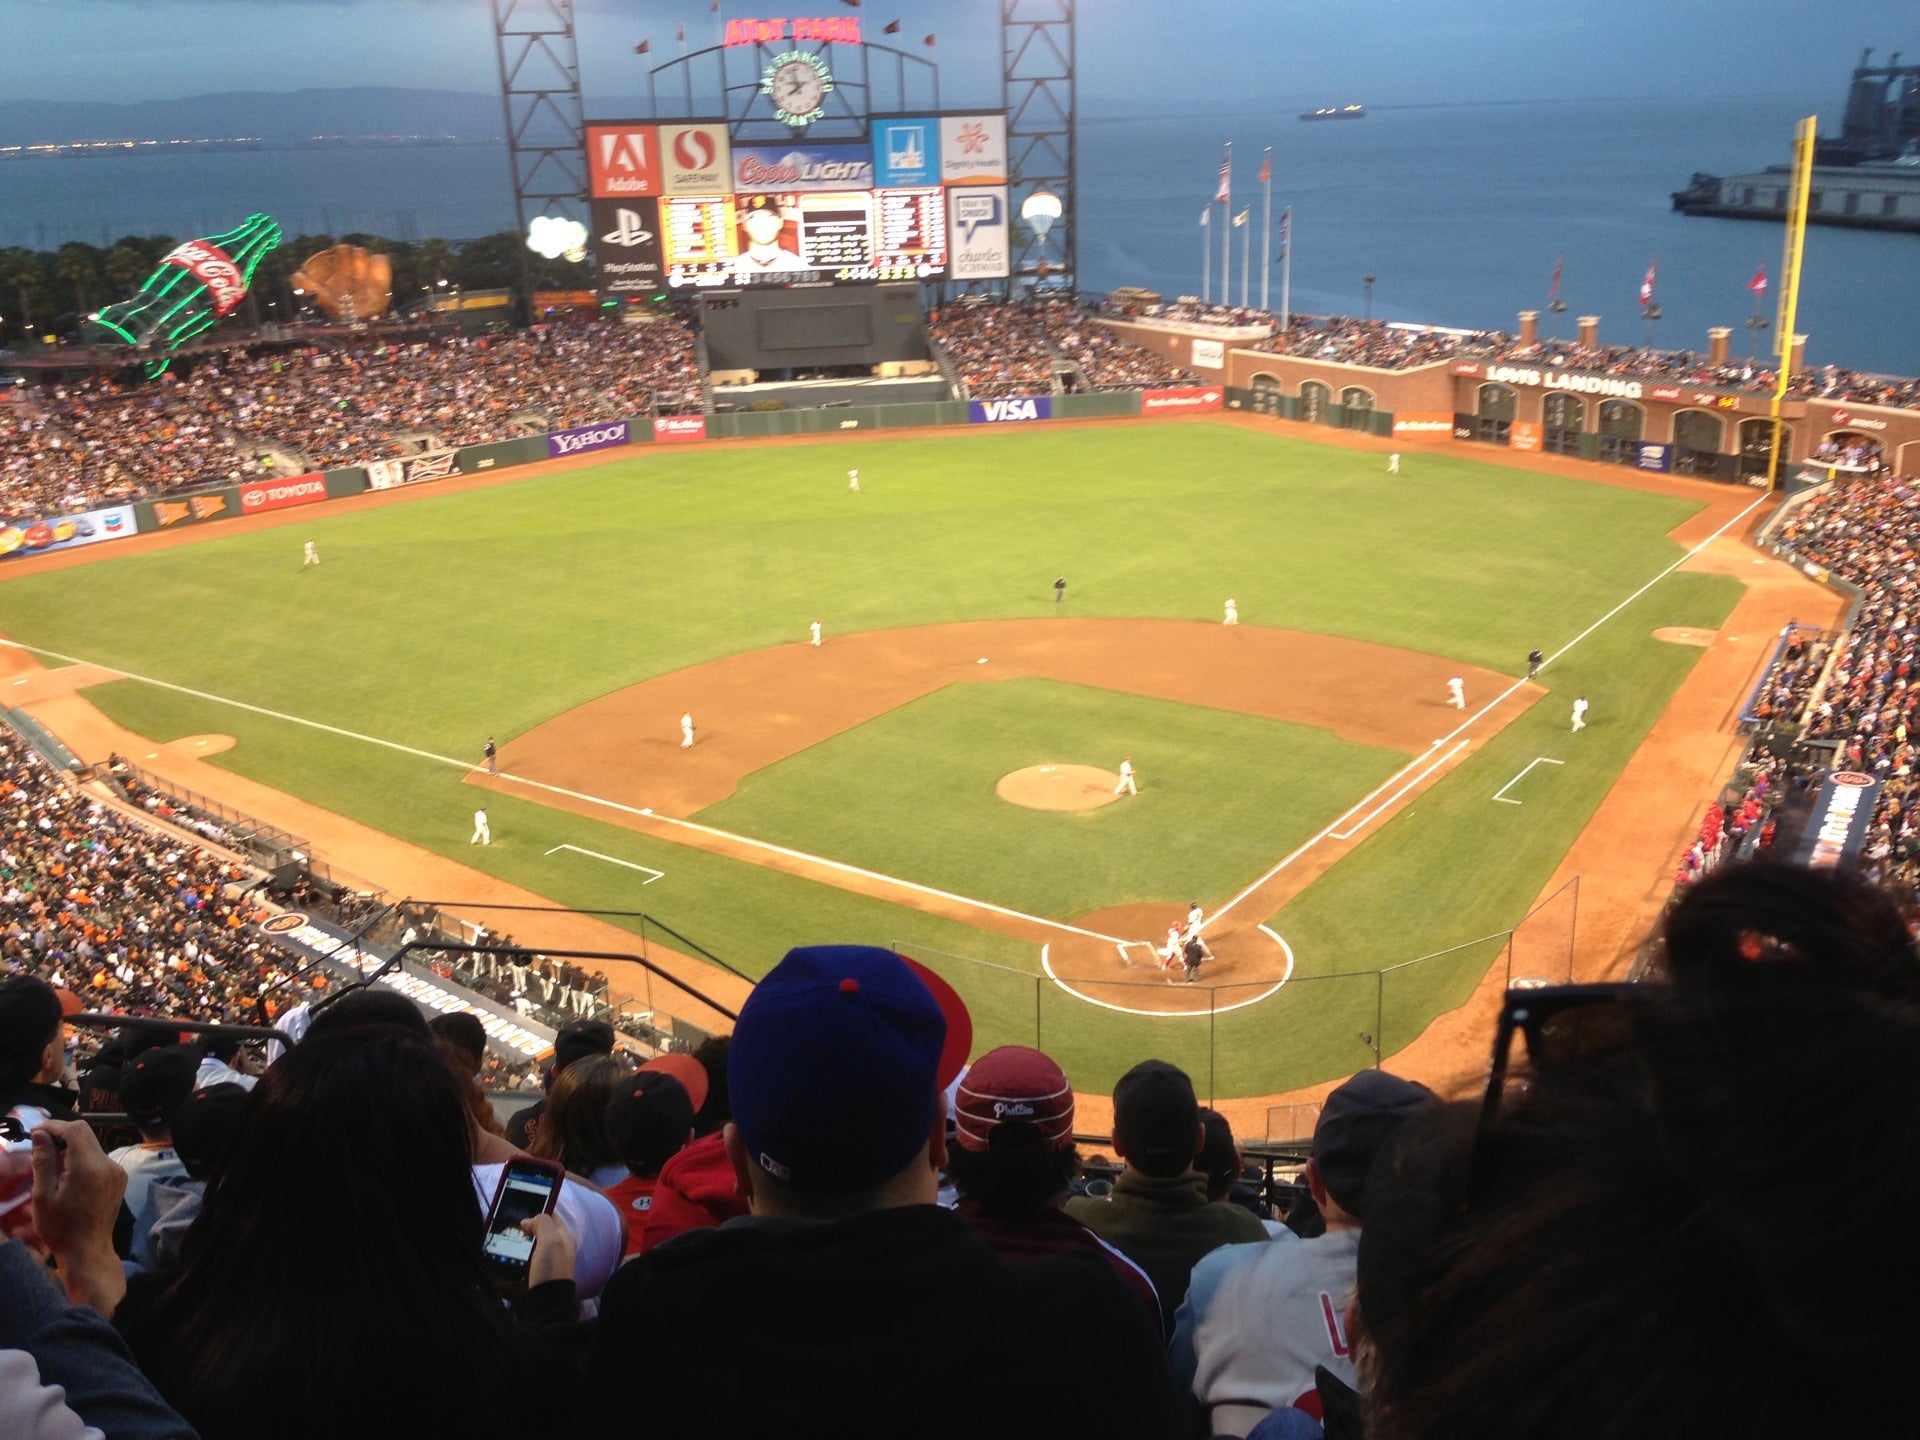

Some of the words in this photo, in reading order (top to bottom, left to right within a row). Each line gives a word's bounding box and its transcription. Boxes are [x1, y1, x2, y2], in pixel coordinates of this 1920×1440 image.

[724, 18, 788, 47] AT&T
[791, 17, 862, 45] PARK
[773, 107, 825, 127] GIANTS
[738, 155, 800, 185] Coors
[800, 161, 869, 181] LIGHT
[606, 176, 649, 192] Adobe
[603, 262, 659, 275] PlayStation
[1544, 372, 1643, 399] LANDING
[980, 400, 1038, 422] VISA
[551, 424, 626, 454] YAHOO!
[265, 481, 325, 501] TOYOTA
